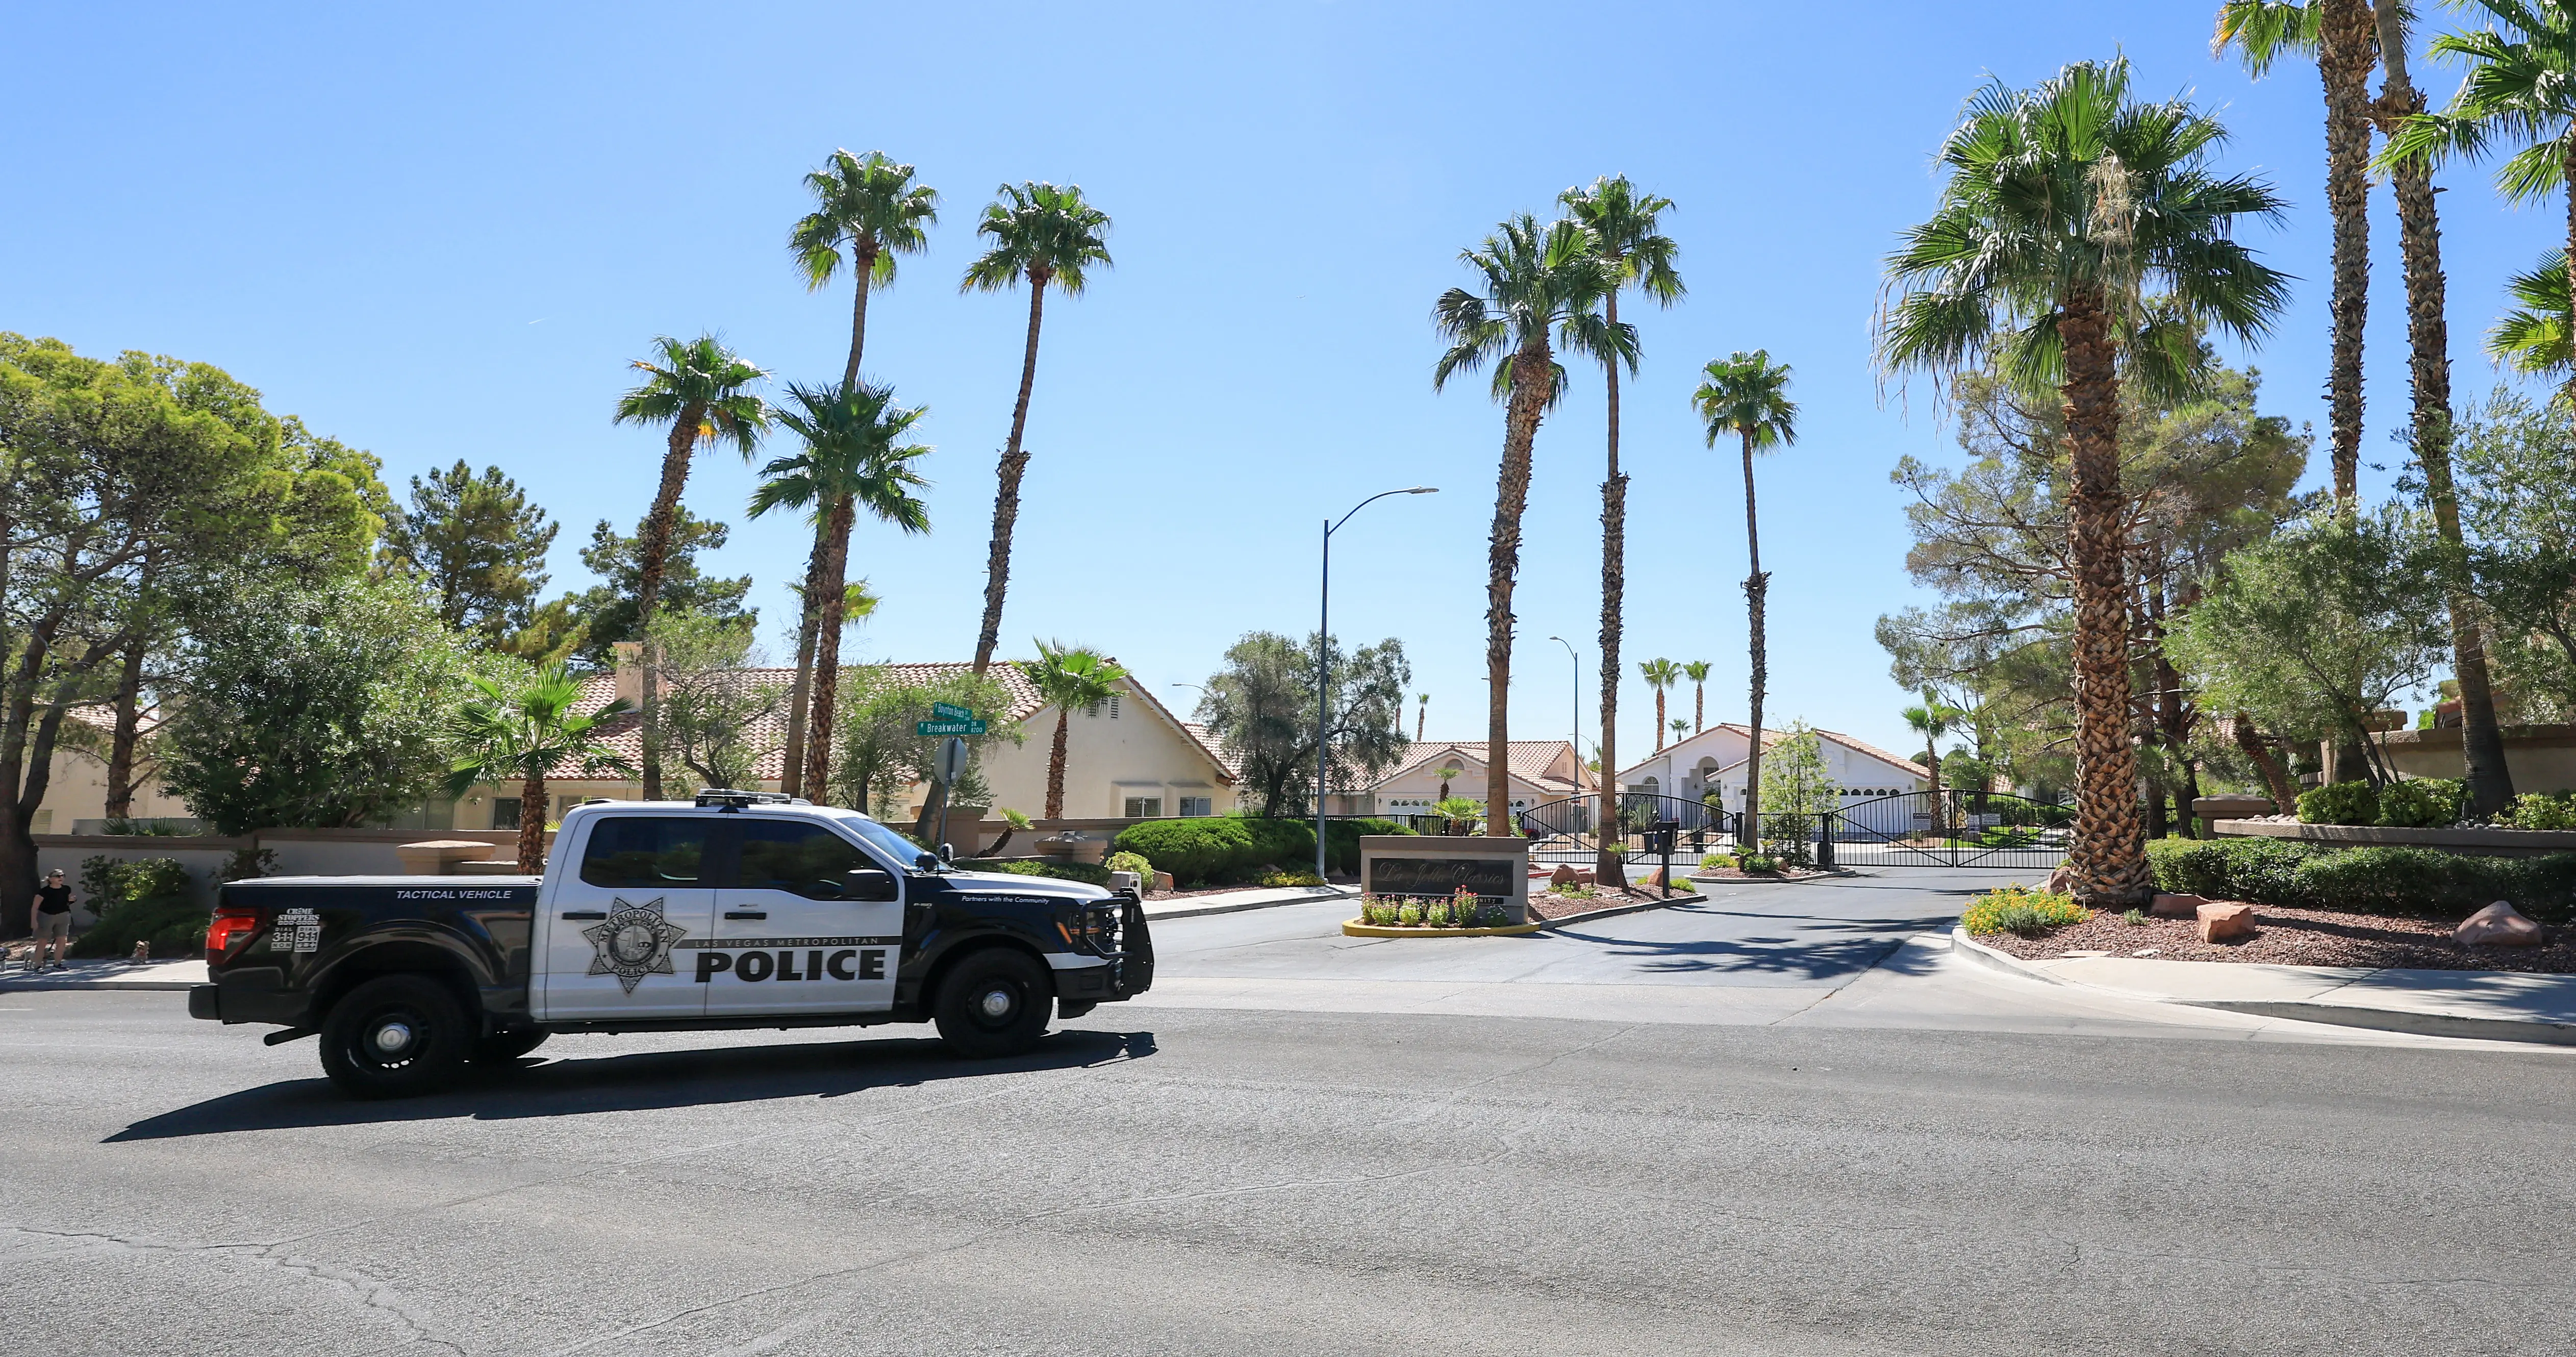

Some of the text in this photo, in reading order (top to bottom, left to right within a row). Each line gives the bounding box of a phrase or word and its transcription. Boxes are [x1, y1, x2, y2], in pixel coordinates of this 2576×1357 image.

[938, 703, 953, 716] Boynton
[954, 707, 965, 718] Beach
[927, 723, 967, 733] Breakwater
[1451, 863, 1505, 885] Classics
[396, 890, 512, 899] TACTICAL VEHICLE
[1015, 897, 1050, 905] Community
[600, 910, 668, 943] METROPOLITAN
[614, 920, 655, 935] LAS VEGAS
[726, 939, 769, 947] VEGAS
[776, 937, 878, 946] METROPOLITAN
[612, 963, 654, 976] POLICE
[694, 949, 886, 983] POLICE
